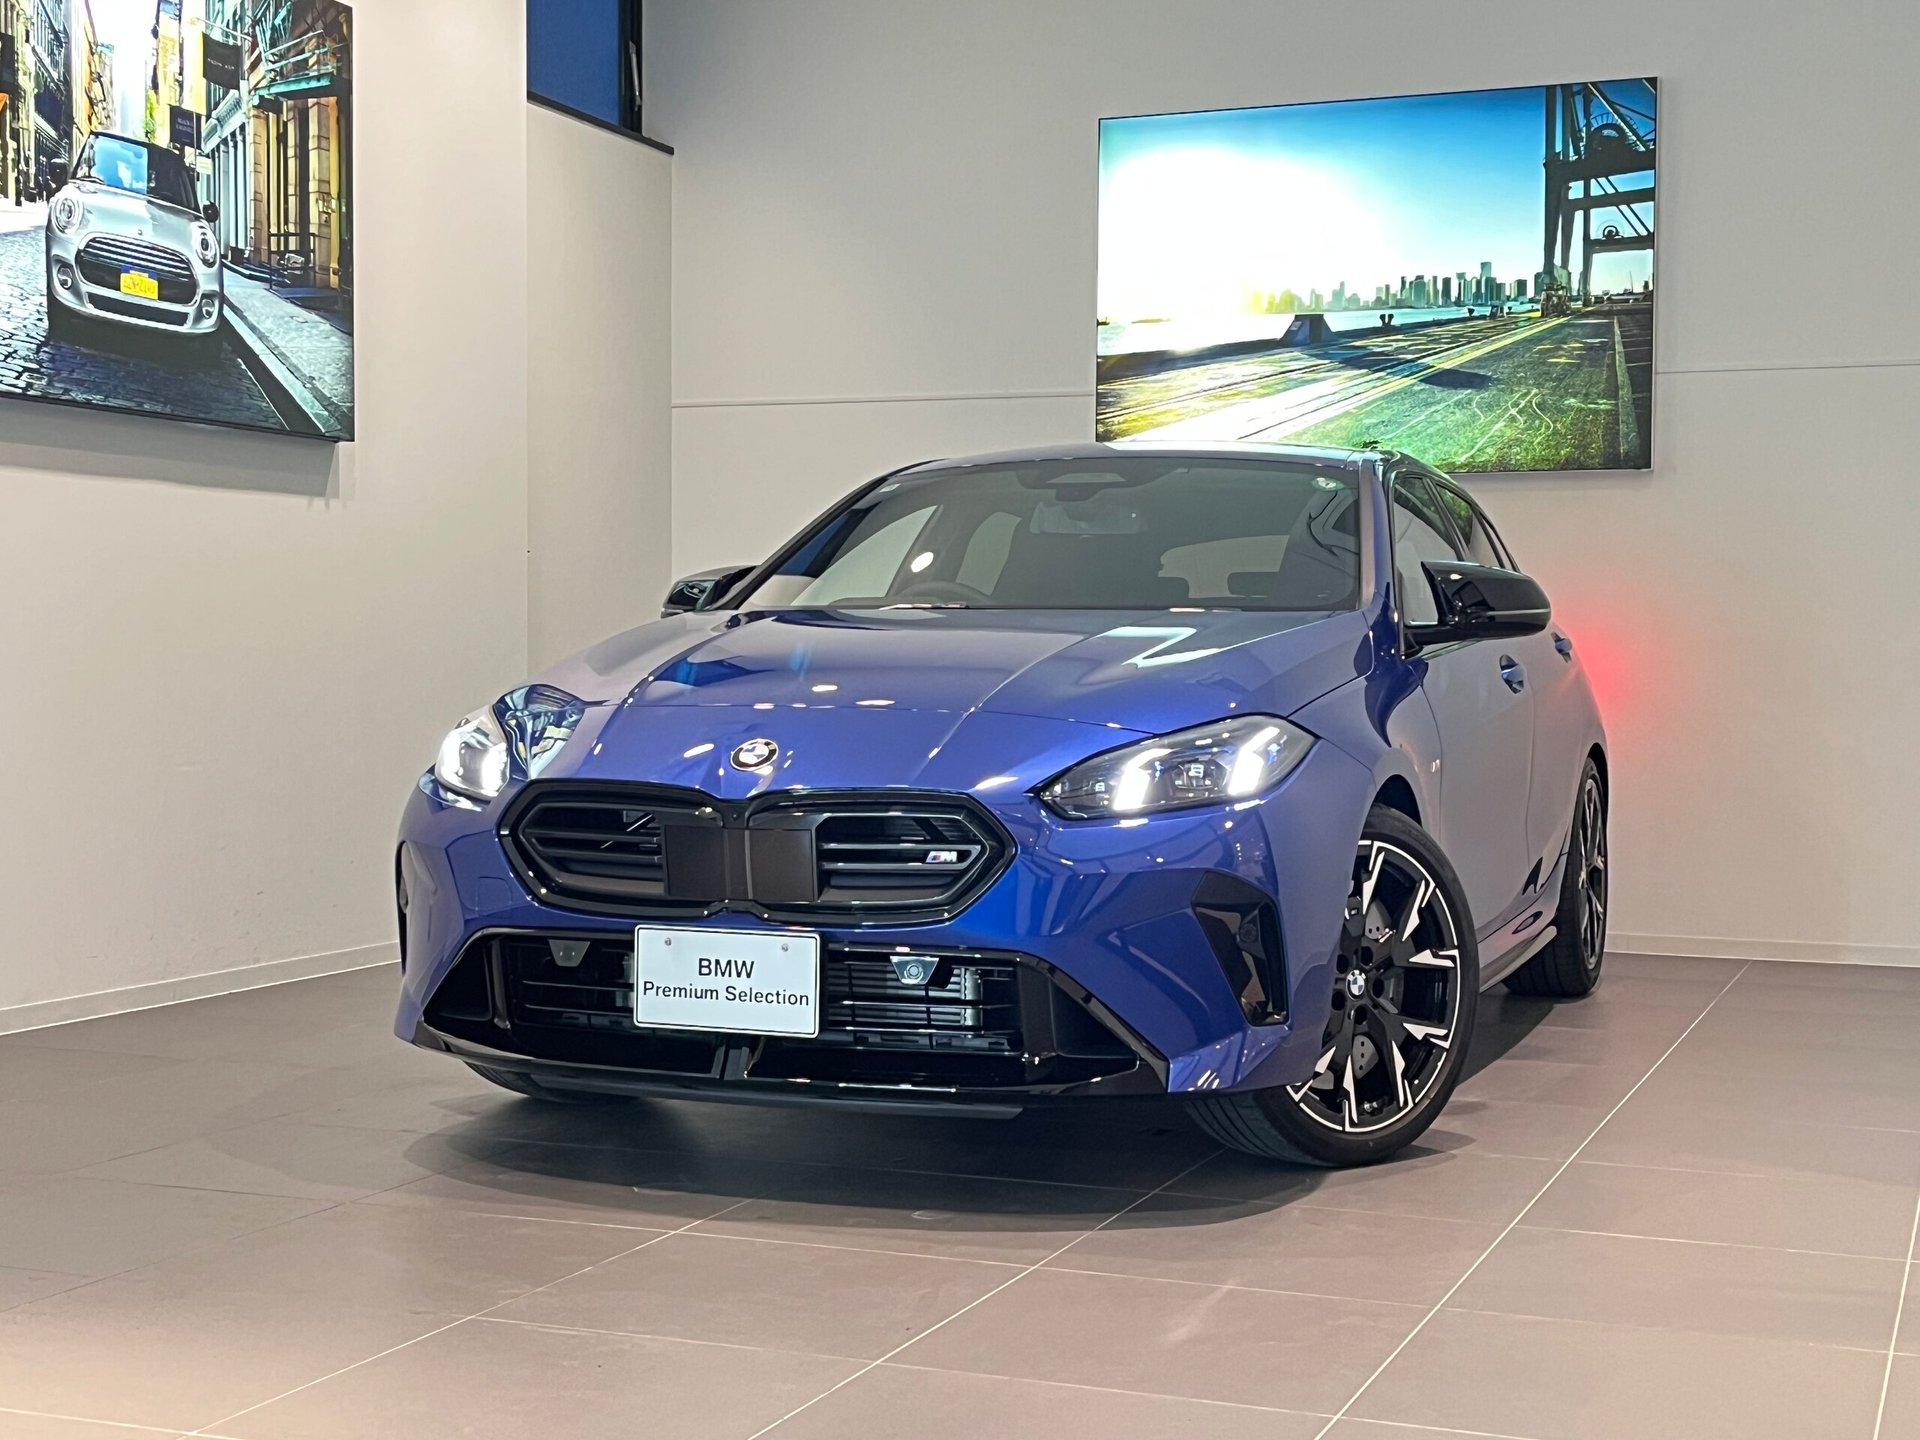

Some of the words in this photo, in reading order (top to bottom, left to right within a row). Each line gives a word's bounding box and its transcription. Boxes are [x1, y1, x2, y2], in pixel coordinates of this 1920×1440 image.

[698, 958, 755, 978] BMW
[643, 981, 719, 1000] Premium
[725, 985, 809, 1006] Selection
